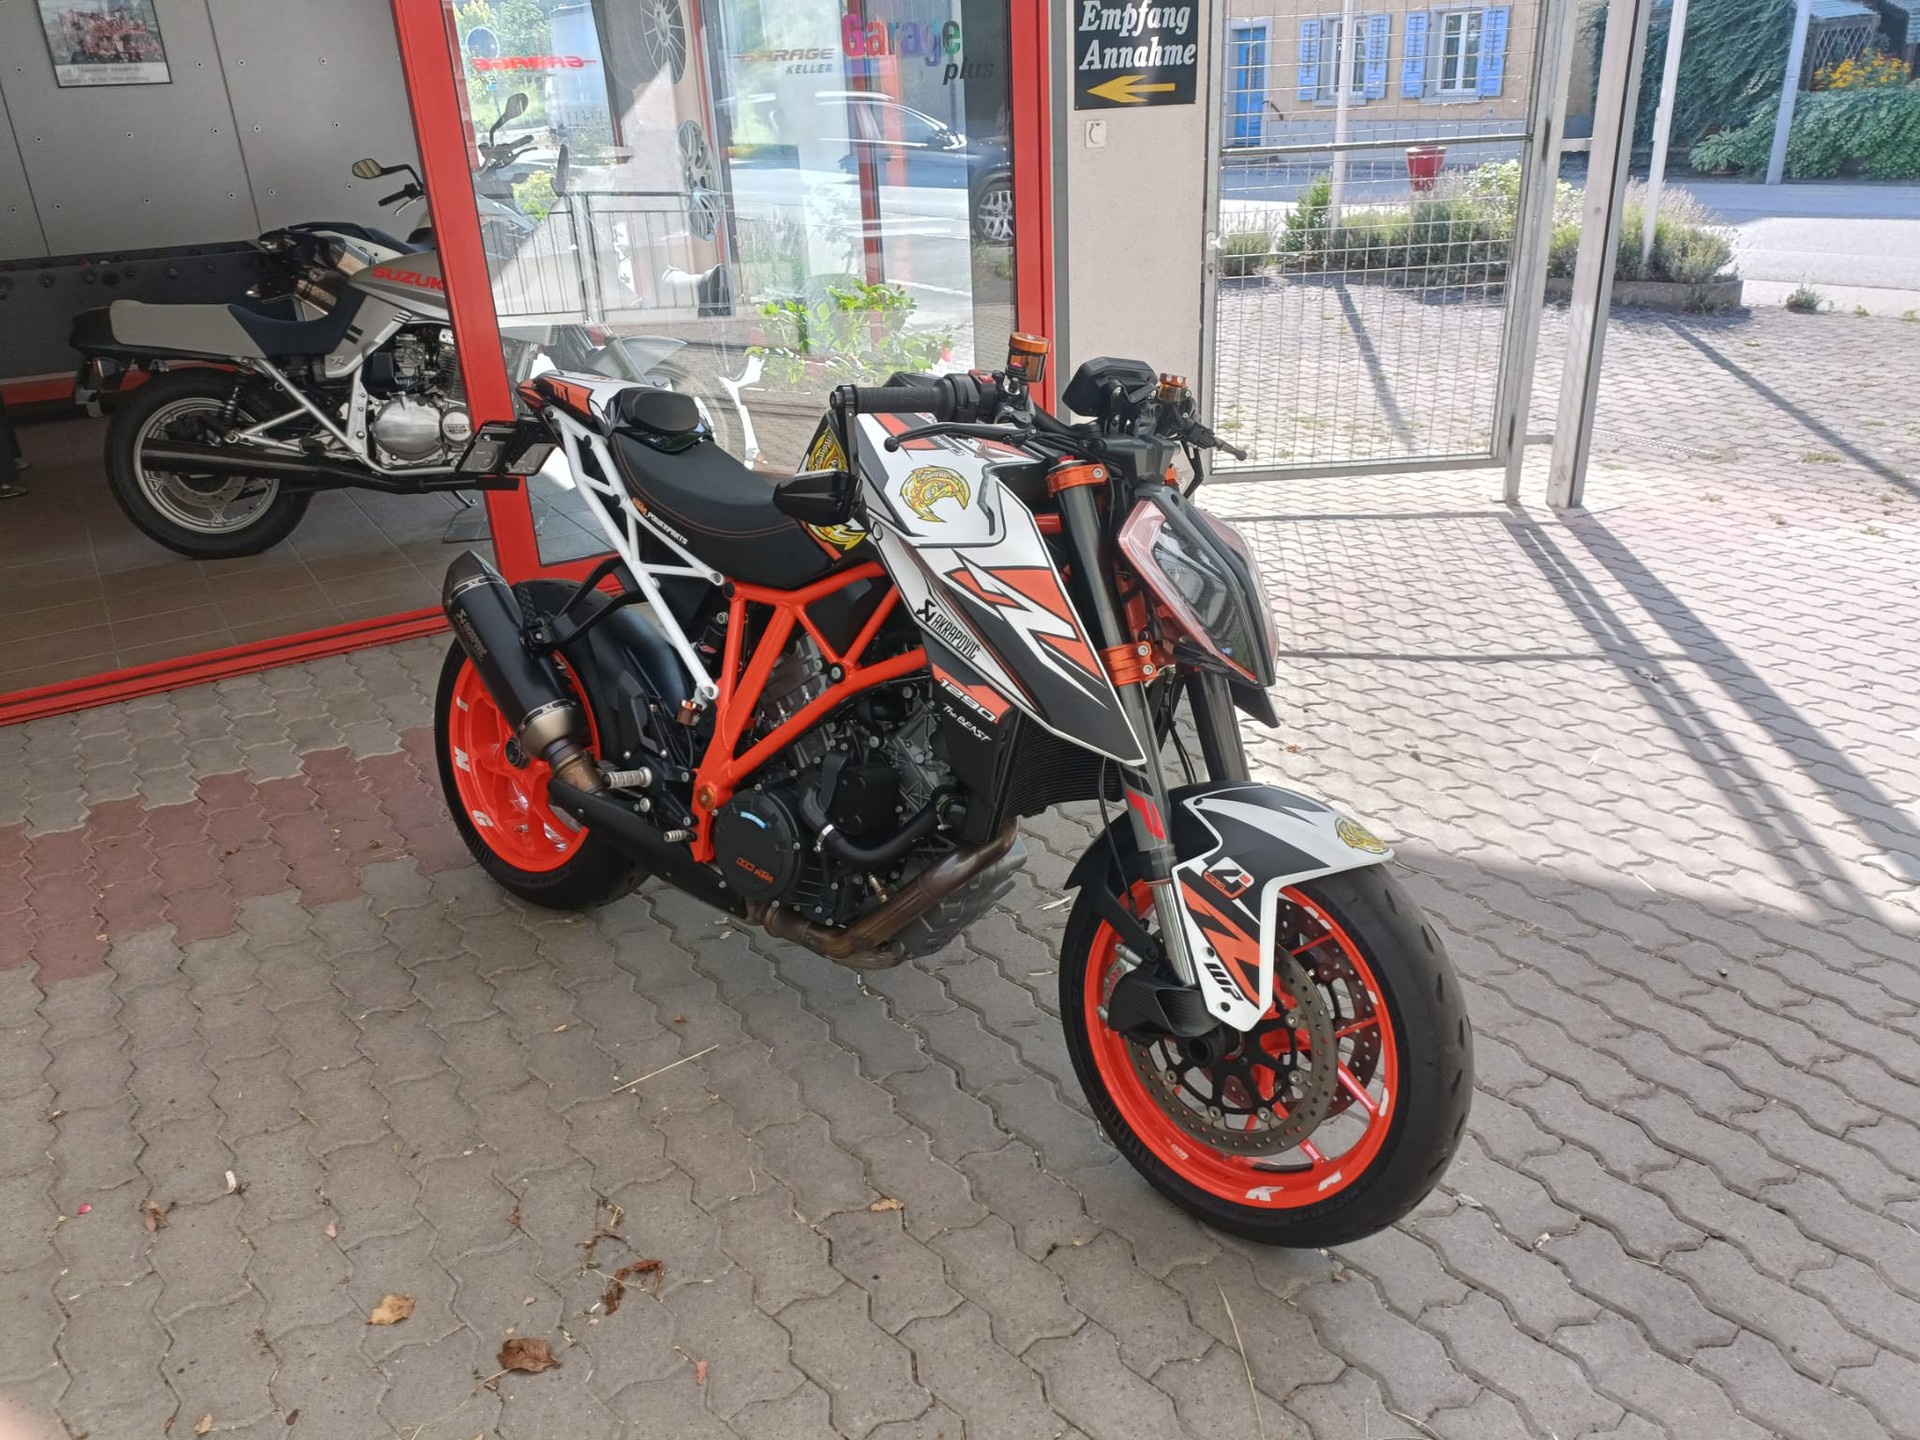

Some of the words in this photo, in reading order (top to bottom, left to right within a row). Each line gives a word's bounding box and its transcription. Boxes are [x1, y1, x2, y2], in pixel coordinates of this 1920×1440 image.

[1079, 0, 1191, 37] Empfang
[841, 13, 961, 67] Garage
[1079, 36, 1197, 70] Annahme
[785, 63, 834, 75] KELLER
[942, 58, 995, 86] plus
[371, 265, 445, 291] SUZUK
[940, 678, 997, 722] 1290
